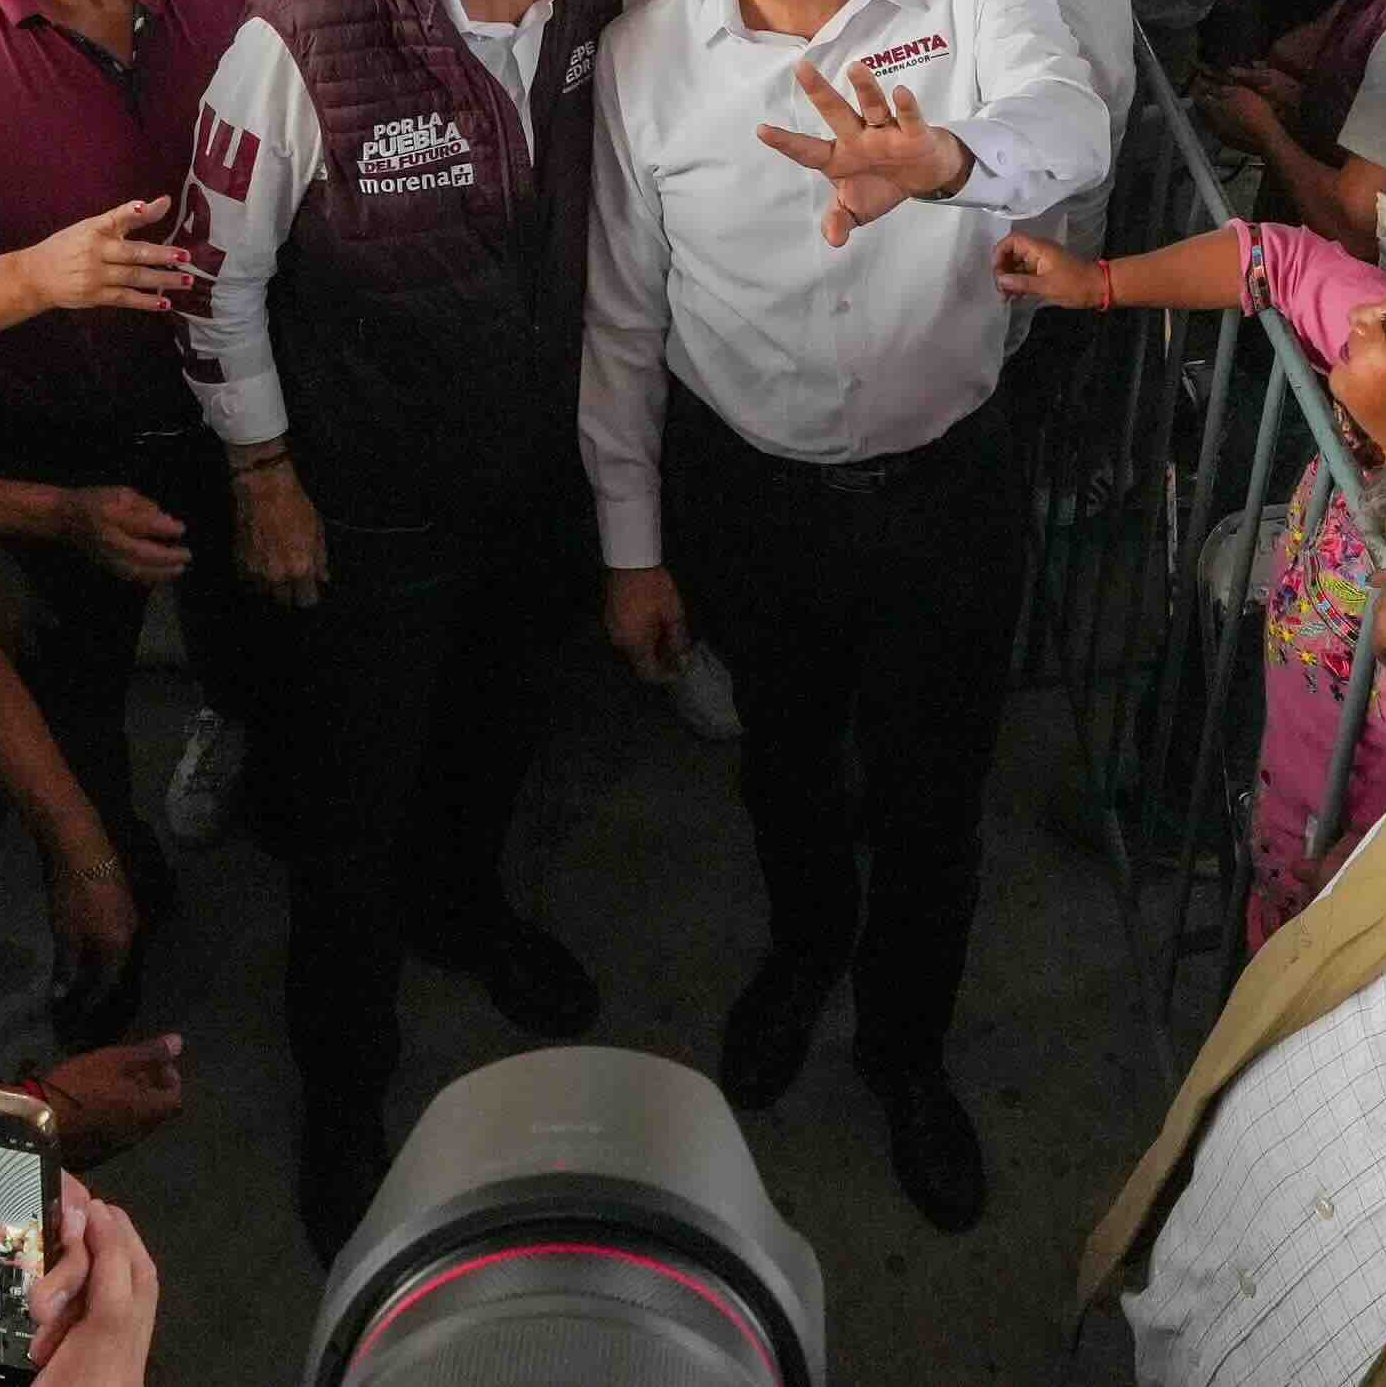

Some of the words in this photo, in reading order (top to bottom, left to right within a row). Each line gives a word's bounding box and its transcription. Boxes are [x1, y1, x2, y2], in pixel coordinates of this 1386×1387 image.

[570, 41, 596, 65] EPE
[861, 34, 949, 70] RMENTA
[875, 53, 931, 77] OBERNADOR
[363, 121, 462, 161] PUEBLA
[373, 117, 413, 141] POR
[417, 112, 444, 131] LA
[365, 158, 393, 174] DEL
[398, 142, 463, 169] FUTURO
[359, 170, 451, 194] morena
